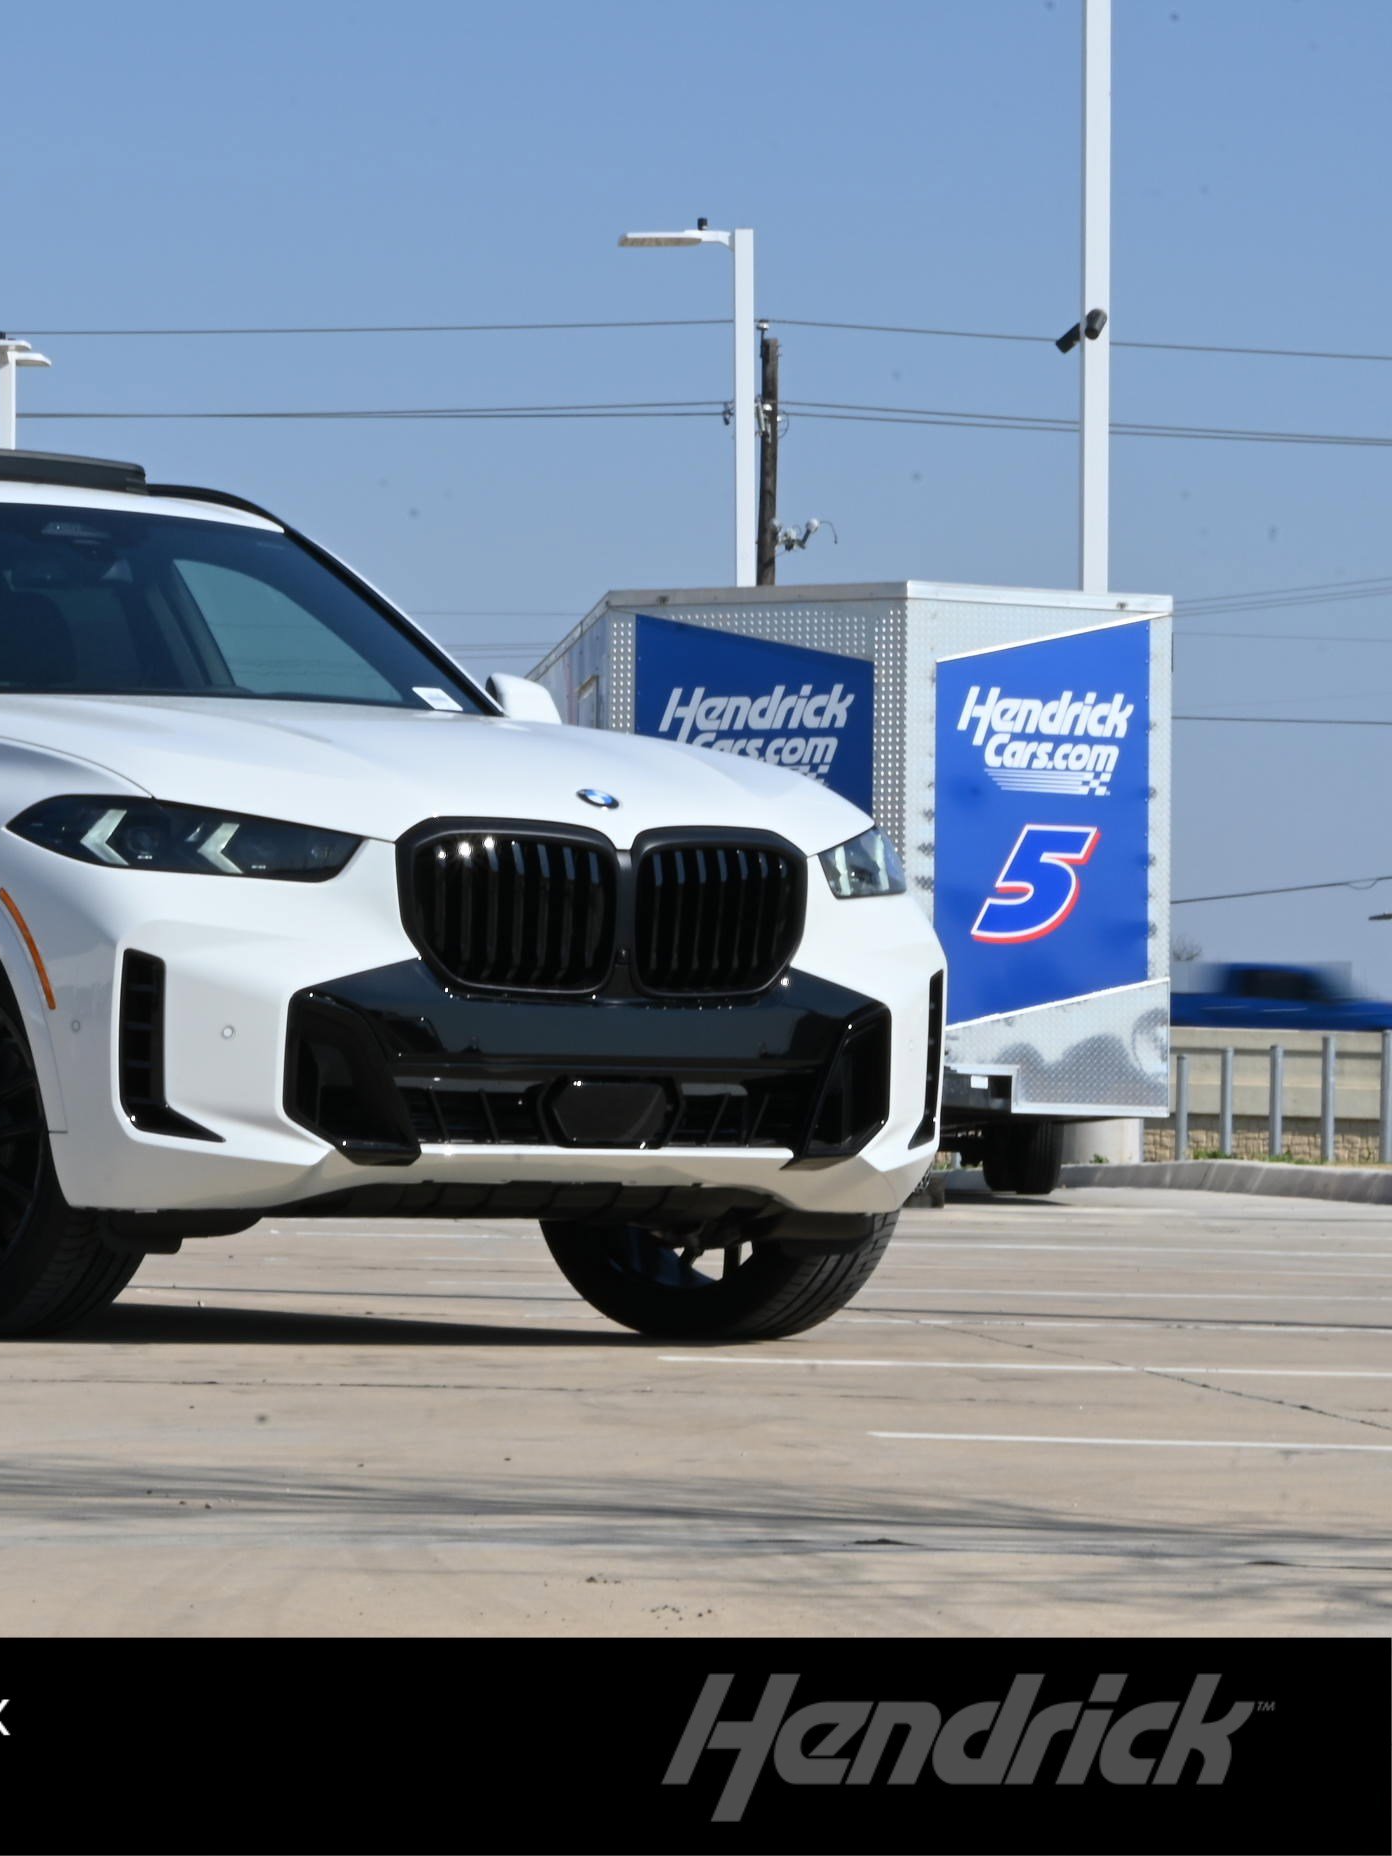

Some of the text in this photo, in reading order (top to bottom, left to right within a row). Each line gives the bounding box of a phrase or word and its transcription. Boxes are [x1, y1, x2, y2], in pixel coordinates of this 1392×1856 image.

[658, 683, 855, 744] Hendrick
[957, 685, 1134, 746] Hendrick
[984, 733, 1120, 772] Cars.com
[970, 824, 1101, 944] 5
